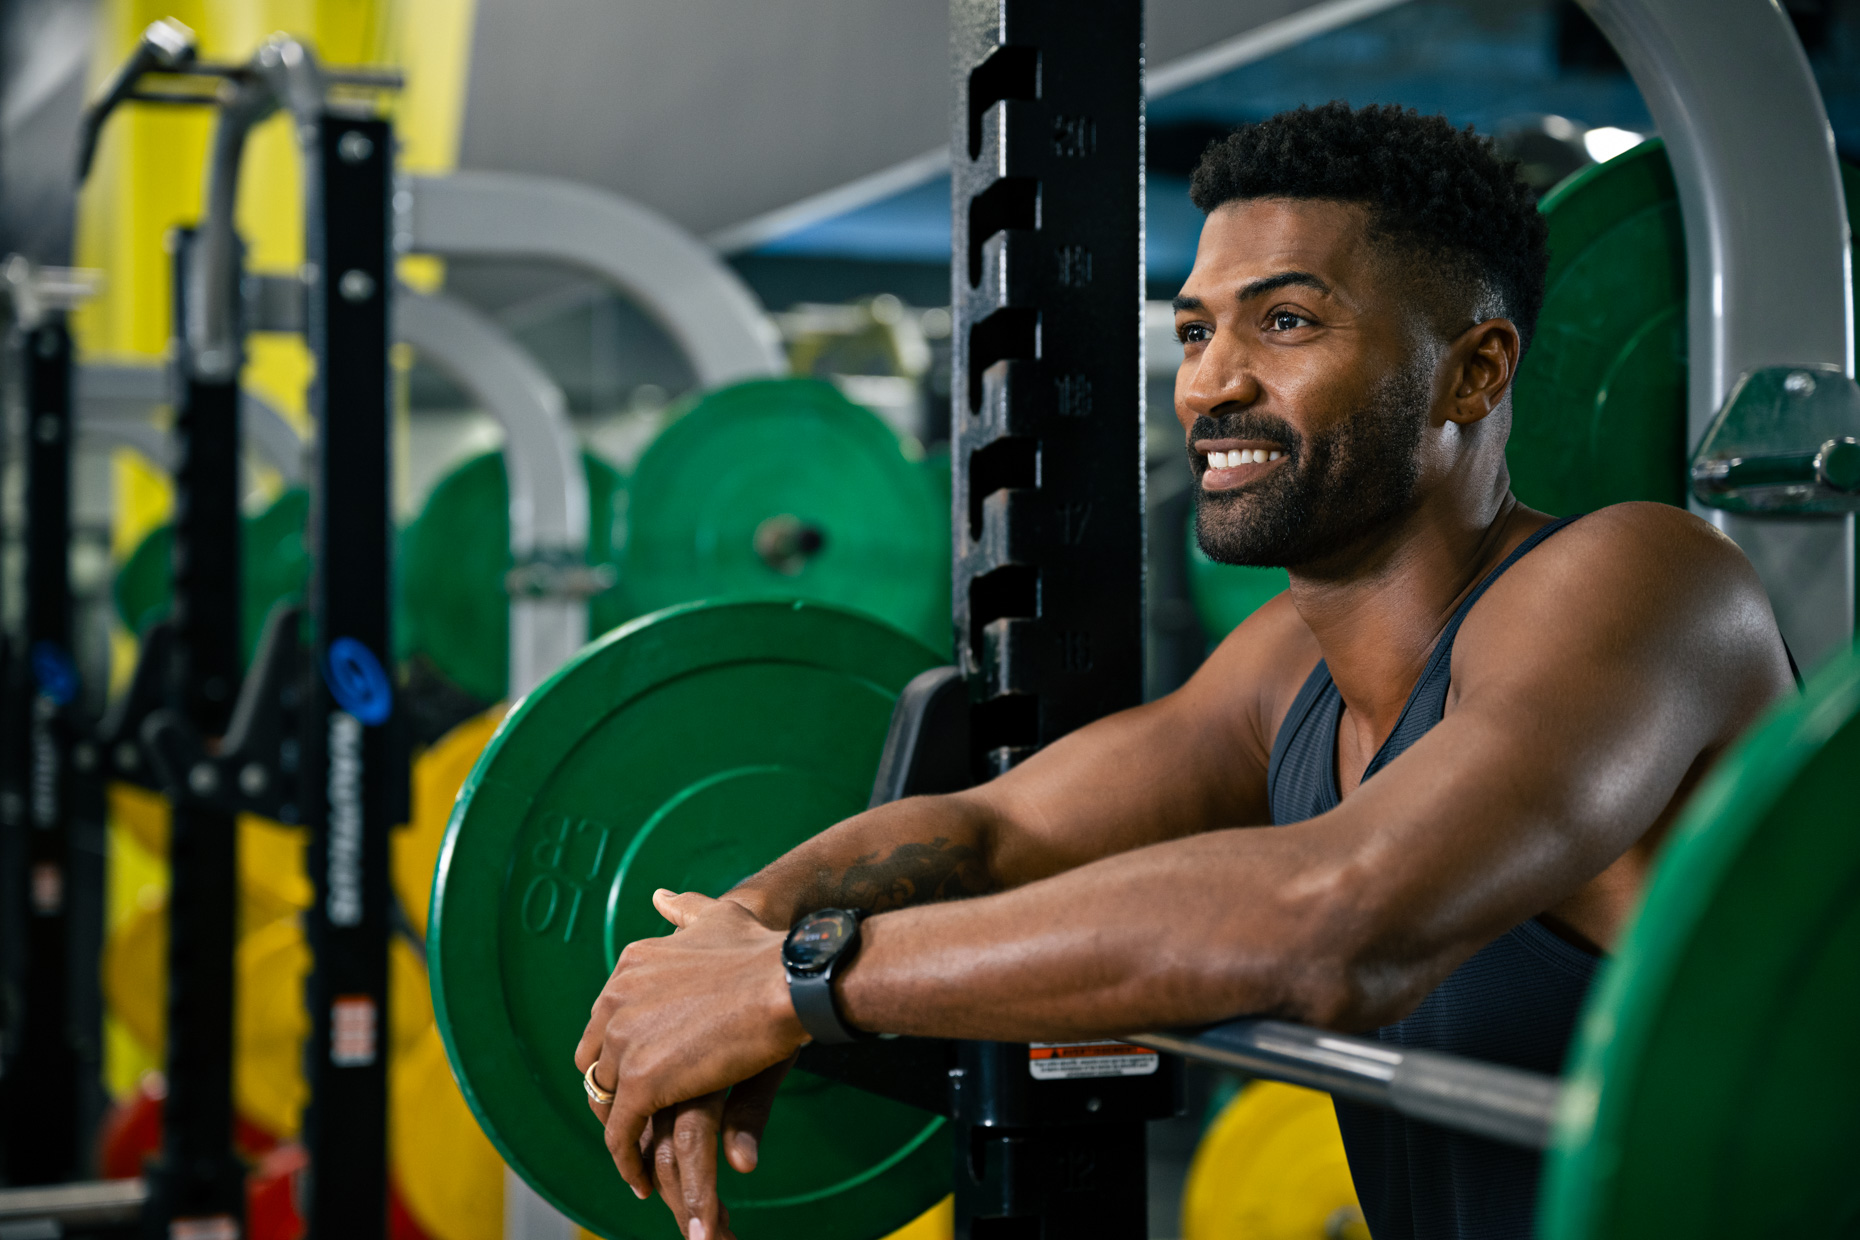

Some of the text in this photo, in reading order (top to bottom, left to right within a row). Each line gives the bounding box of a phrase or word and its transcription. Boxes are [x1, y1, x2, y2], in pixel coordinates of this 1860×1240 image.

[1054, 244, 1092, 287] 19
[1054, 373, 1092, 416] 18
[1056, 502, 1092, 545] 17
[1056, 630, 1093, 672] 16
